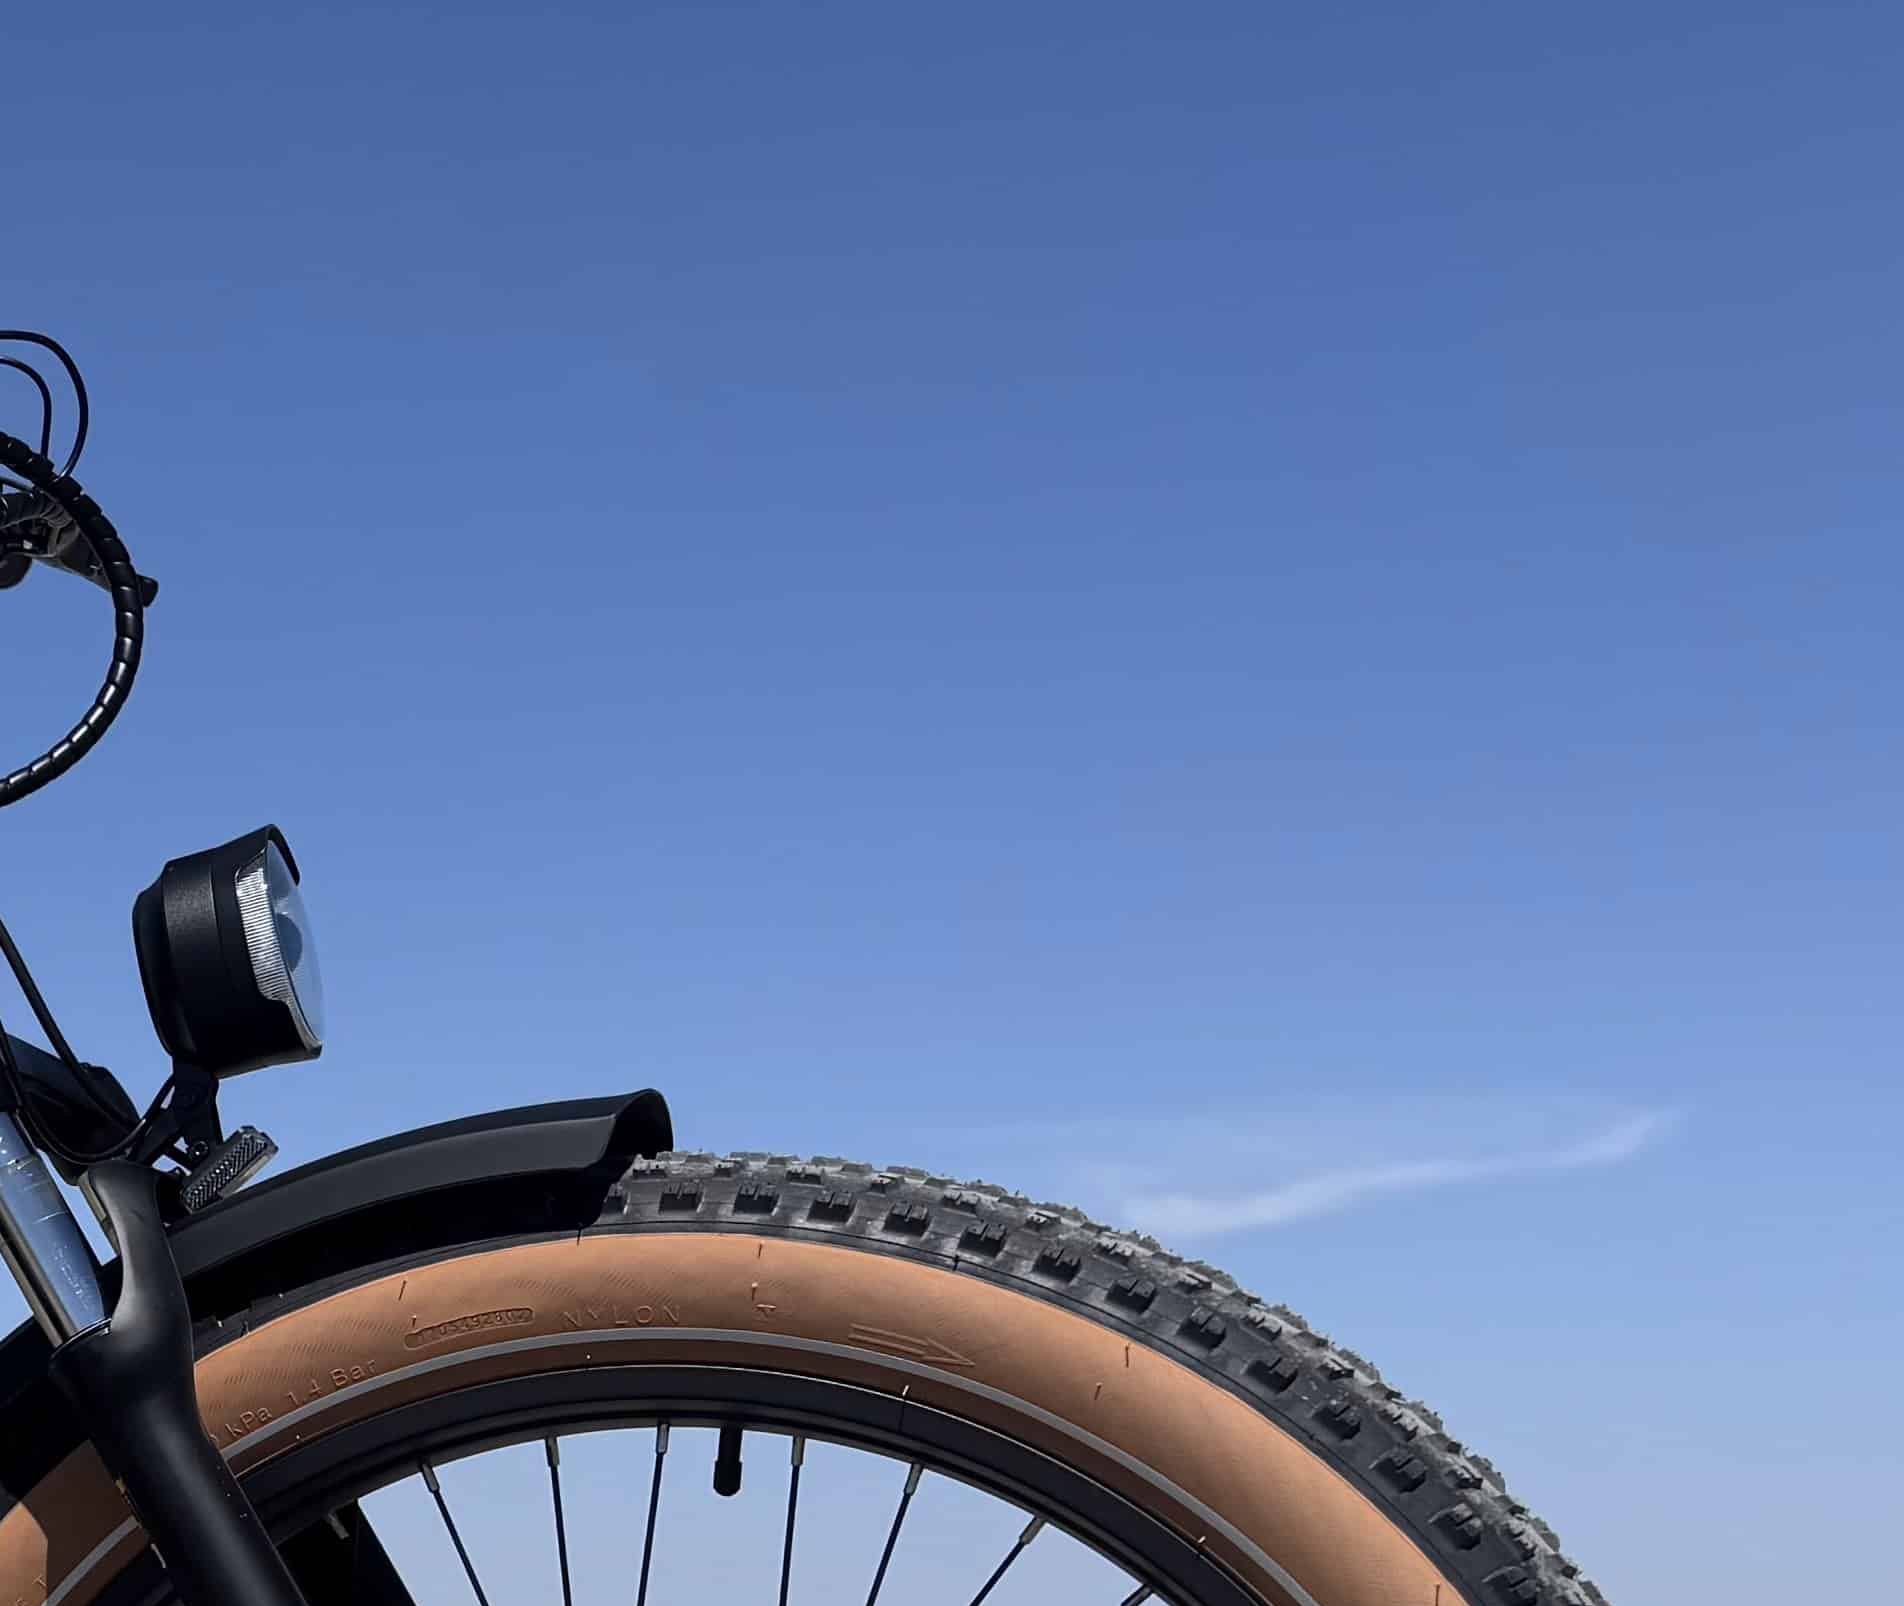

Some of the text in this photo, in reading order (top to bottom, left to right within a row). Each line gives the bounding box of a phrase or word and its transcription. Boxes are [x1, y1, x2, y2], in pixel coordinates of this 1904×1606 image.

[559, 1302, 682, 1329] NYLON
[224, 1405, 273, 1438] kPa
[326, 1358, 378, 1388] Bar
